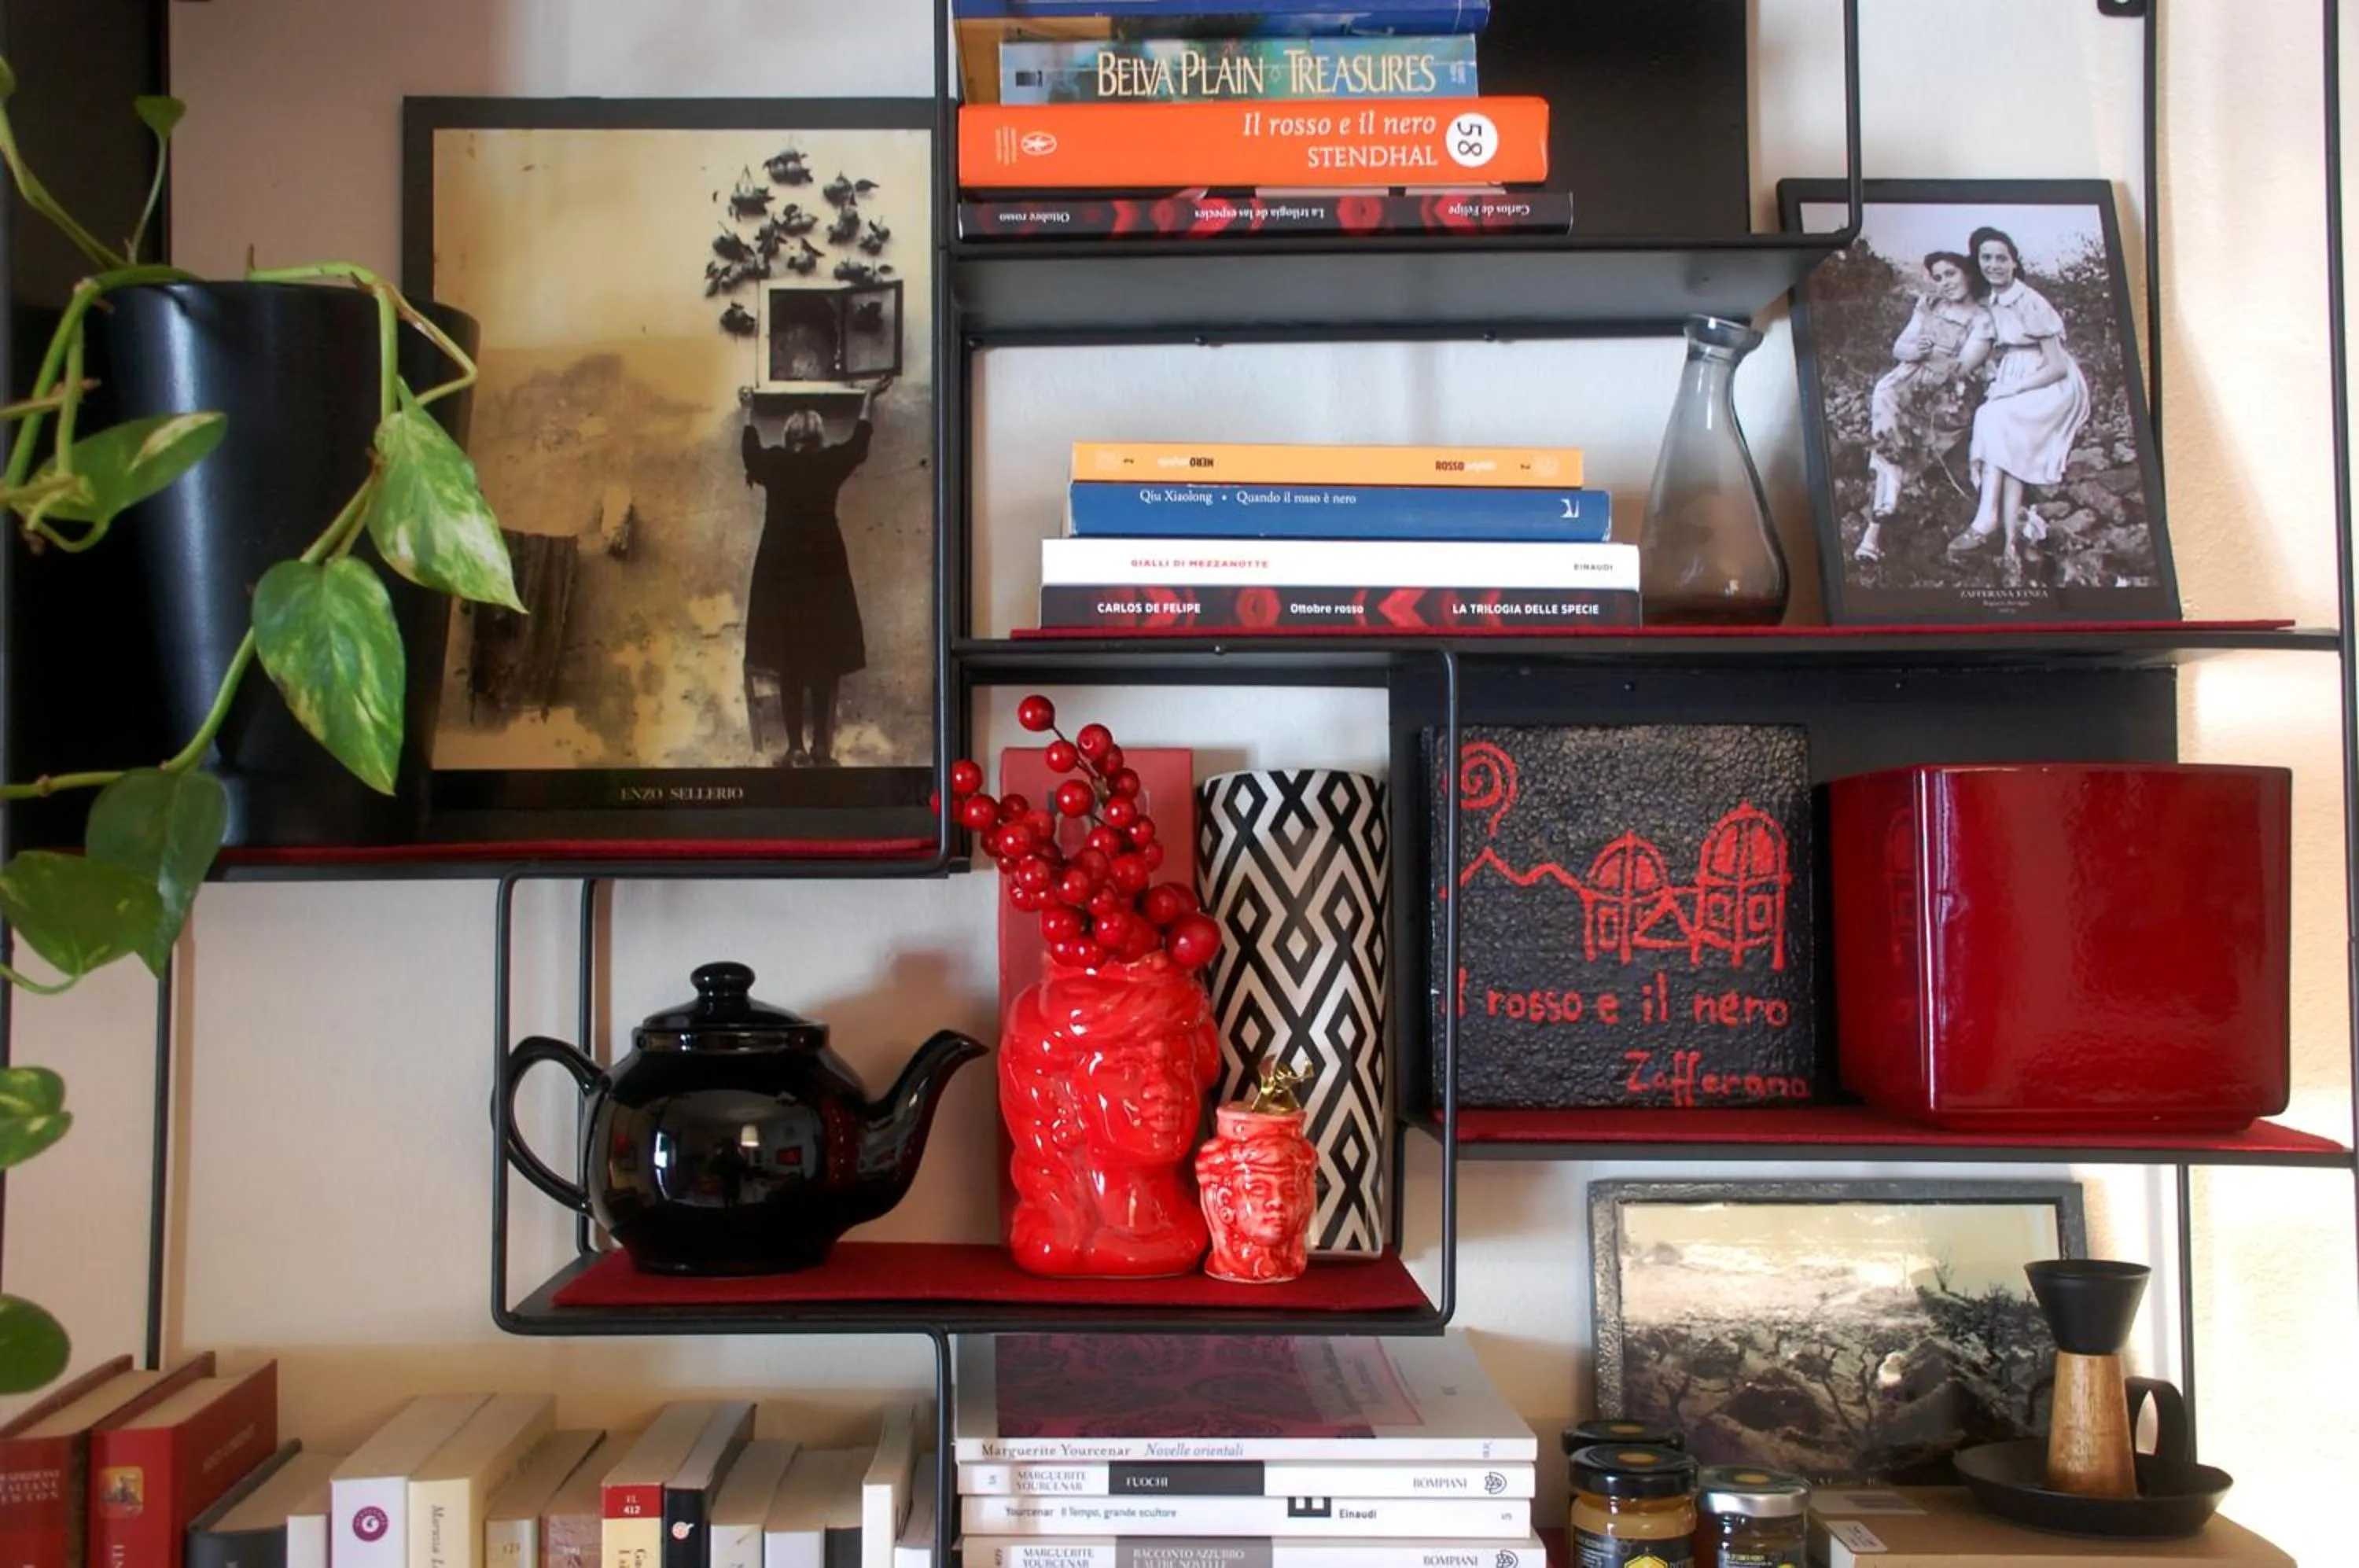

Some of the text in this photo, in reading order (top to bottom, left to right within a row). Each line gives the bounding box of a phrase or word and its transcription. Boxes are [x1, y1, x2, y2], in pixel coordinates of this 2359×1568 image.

[1097, 51, 1174, 96] BELVA
[1181, 50, 1263, 95] PLAIN
[1284, 48, 1437, 94] TREASURES
[1242, 112, 1437, 136] Il rosso e il nero
[1457, 121, 1483, 157] 58
[1308, 145, 1437, 167] STENDHAL
[1239, 208, 1253, 220] las
[1255, 208, 1268, 220] de
[1311, 208, 1324, 219] La
[1448, 203, 1530, 218] Carlos de Felipe
[999, 212, 1070, 223] Ottobre rosso
[1189, 457, 1214, 468] NERO
[1435, 460, 1465, 471] ROSSO
[1139, 490, 1213, 505] Qiu Xiaolong
[1235, 491, 1356, 506] Quando il rosso è nero
[1131, 559, 1269, 569] GIALLI DI MEZZANOTTE
[1573, 563, 1614, 572] EINAUDI
[1097, 602, 1202, 615] CARLOS DE FELIPE
[1290, 602, 1365, 615] Ottobre rosso
[1452, 603, 1599, 616] LA TRILOGIA DELLE SPECIE
[620, 786, 744, 801] ENZO SELLERIO
[1486, 988, 1583, 1024] rosso
[1597, 992, 1621, 1025] e
[1641, 969, 1670, 1025] il
[1694, 990, 1789, 1027] nero
[981, 1442, 1244, 1459] Marguerite Yourcenar Novelle orientali
[1017, 1470, 1087, 1481] MARGUERITE
[1016, 1482, 1084, 1491] YOURCENAR
[1126, 1475, 1168, 1489] FUOCHI
[1413, 1477, 1468, 1489] BOMPIANI
[623, 1504, 642, 1515] 412
[1006, 1507, 1054, 1518] Yourcenar
[1103, 1507, 1136, 1520] grande
[1139, 1507, 1177, 1518] scultore
[1339, 1508, 1377, 1519] Einaudi
[1023, 1548, 1095, 1559] MARGUERITE
[1133, 1548, 1194, 1559] RACCONTO
[1022, 1559, 1090, 1568] YOURCENAR
[1422, 1555, 1478, 1567] BOMPIANI
